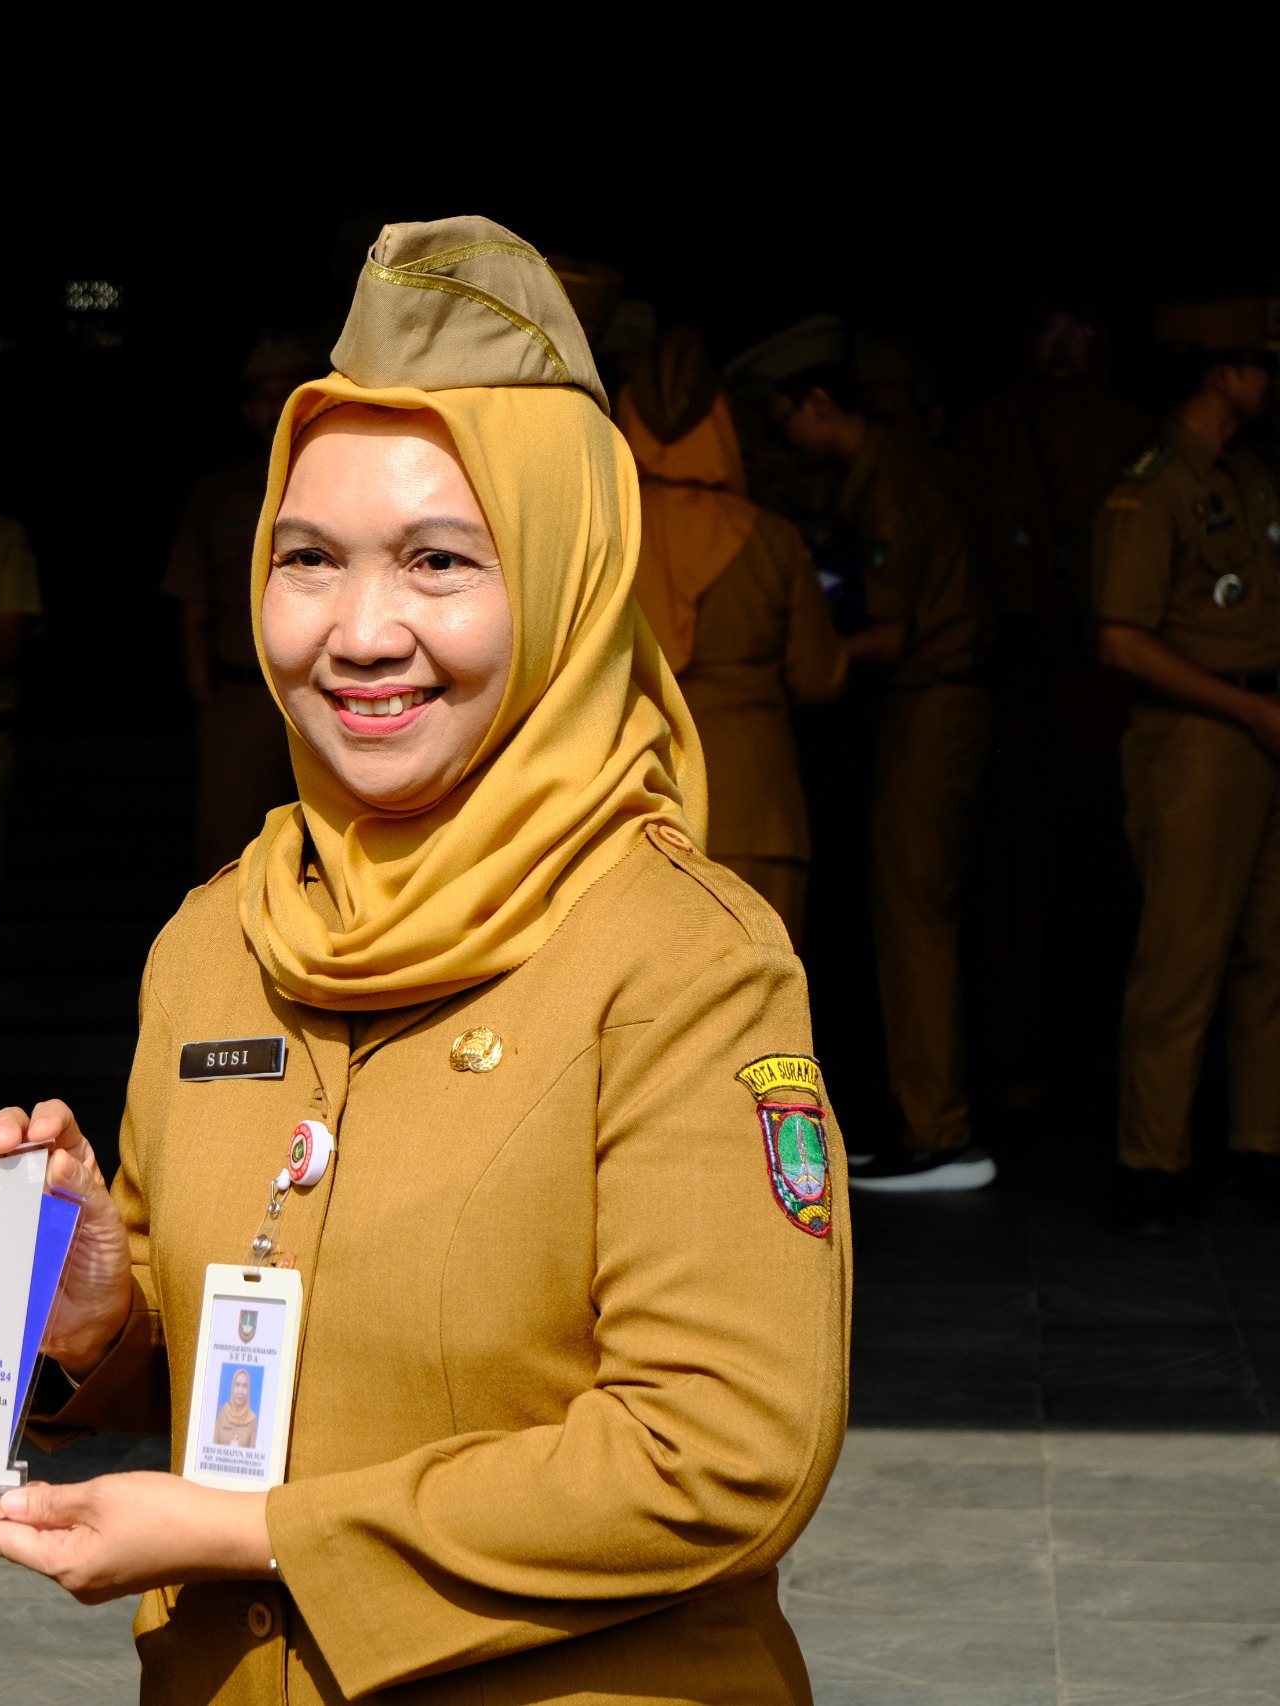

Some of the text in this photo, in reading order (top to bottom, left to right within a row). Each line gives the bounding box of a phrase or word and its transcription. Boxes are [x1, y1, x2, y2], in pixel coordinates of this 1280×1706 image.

[206, 1050, 249, 1067] SUSI
[743, 1064, 777, 1091] KOTA
[229, 1352, 258, 1363] SETDA
